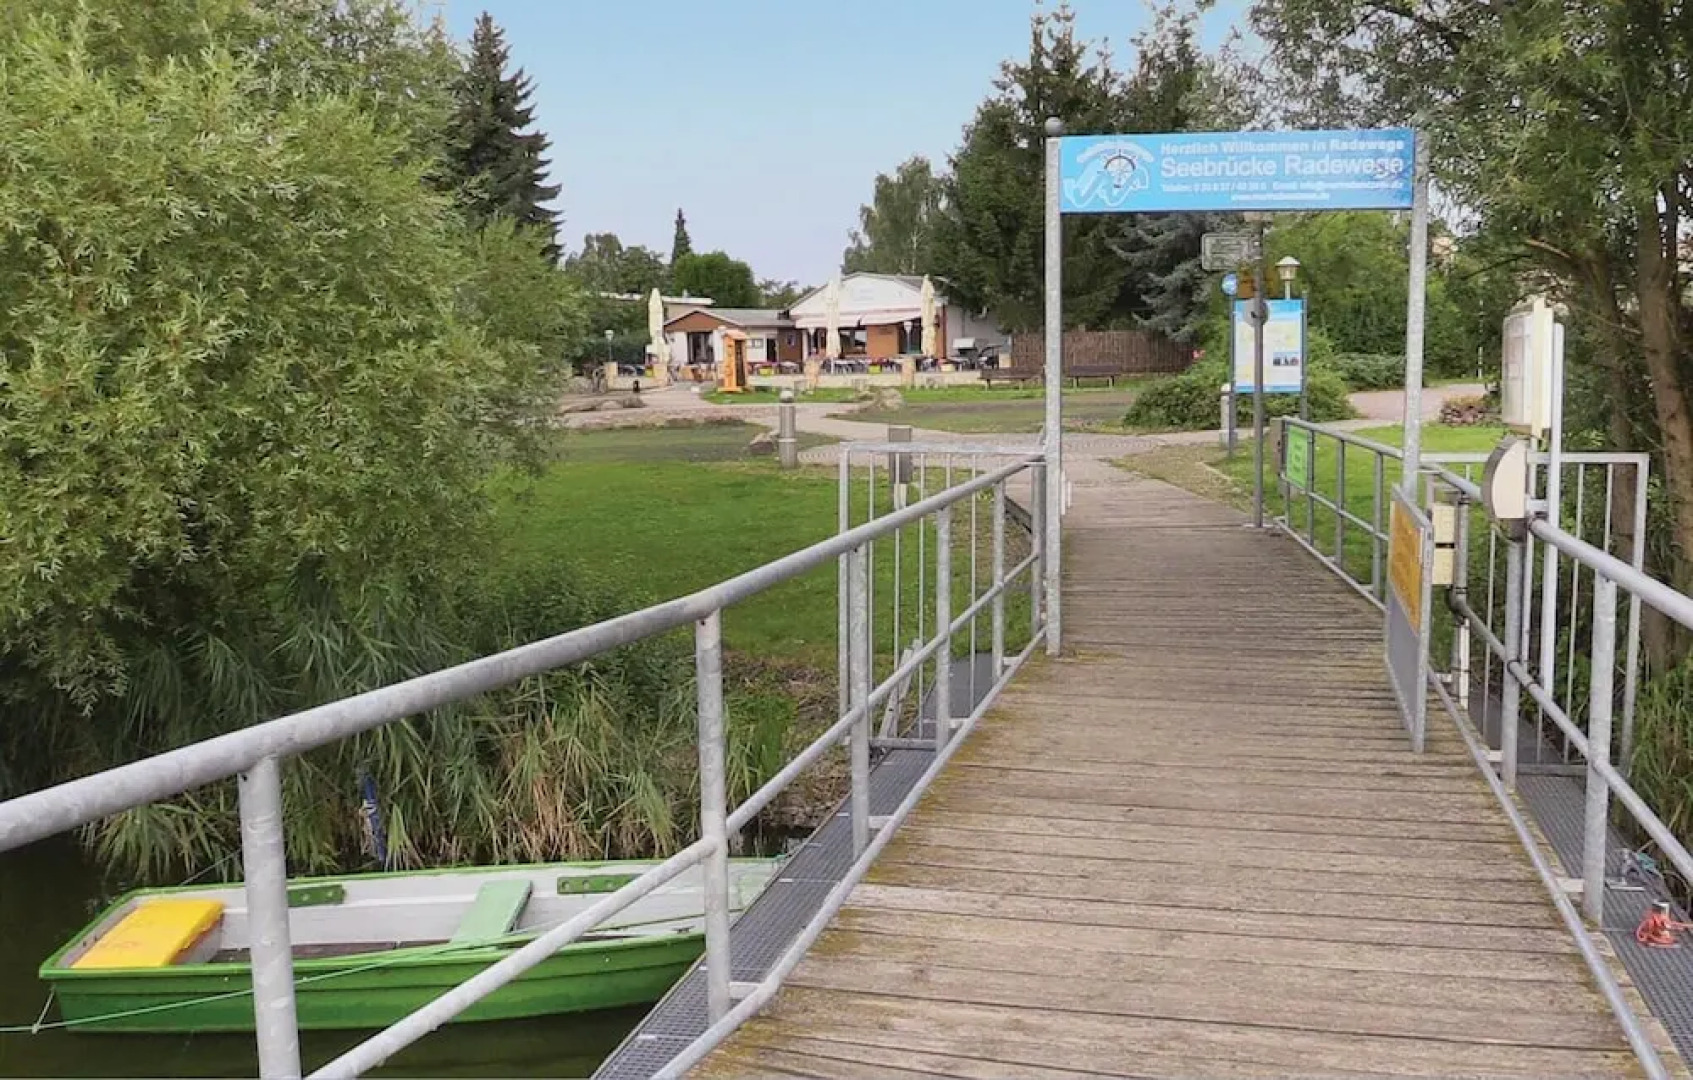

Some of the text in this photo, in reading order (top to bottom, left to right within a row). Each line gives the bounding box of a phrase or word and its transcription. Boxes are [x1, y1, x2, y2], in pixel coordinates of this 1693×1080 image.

[1160, 141, 1218, 155] Herzlich
[1220, 140, 1309, 154] Willkommen
[1312, 139, 1328, 152] in
[1329, 138, 1405, 152] Radewege
[1160, 153, 1404, 179] Seebrücke Radewege
